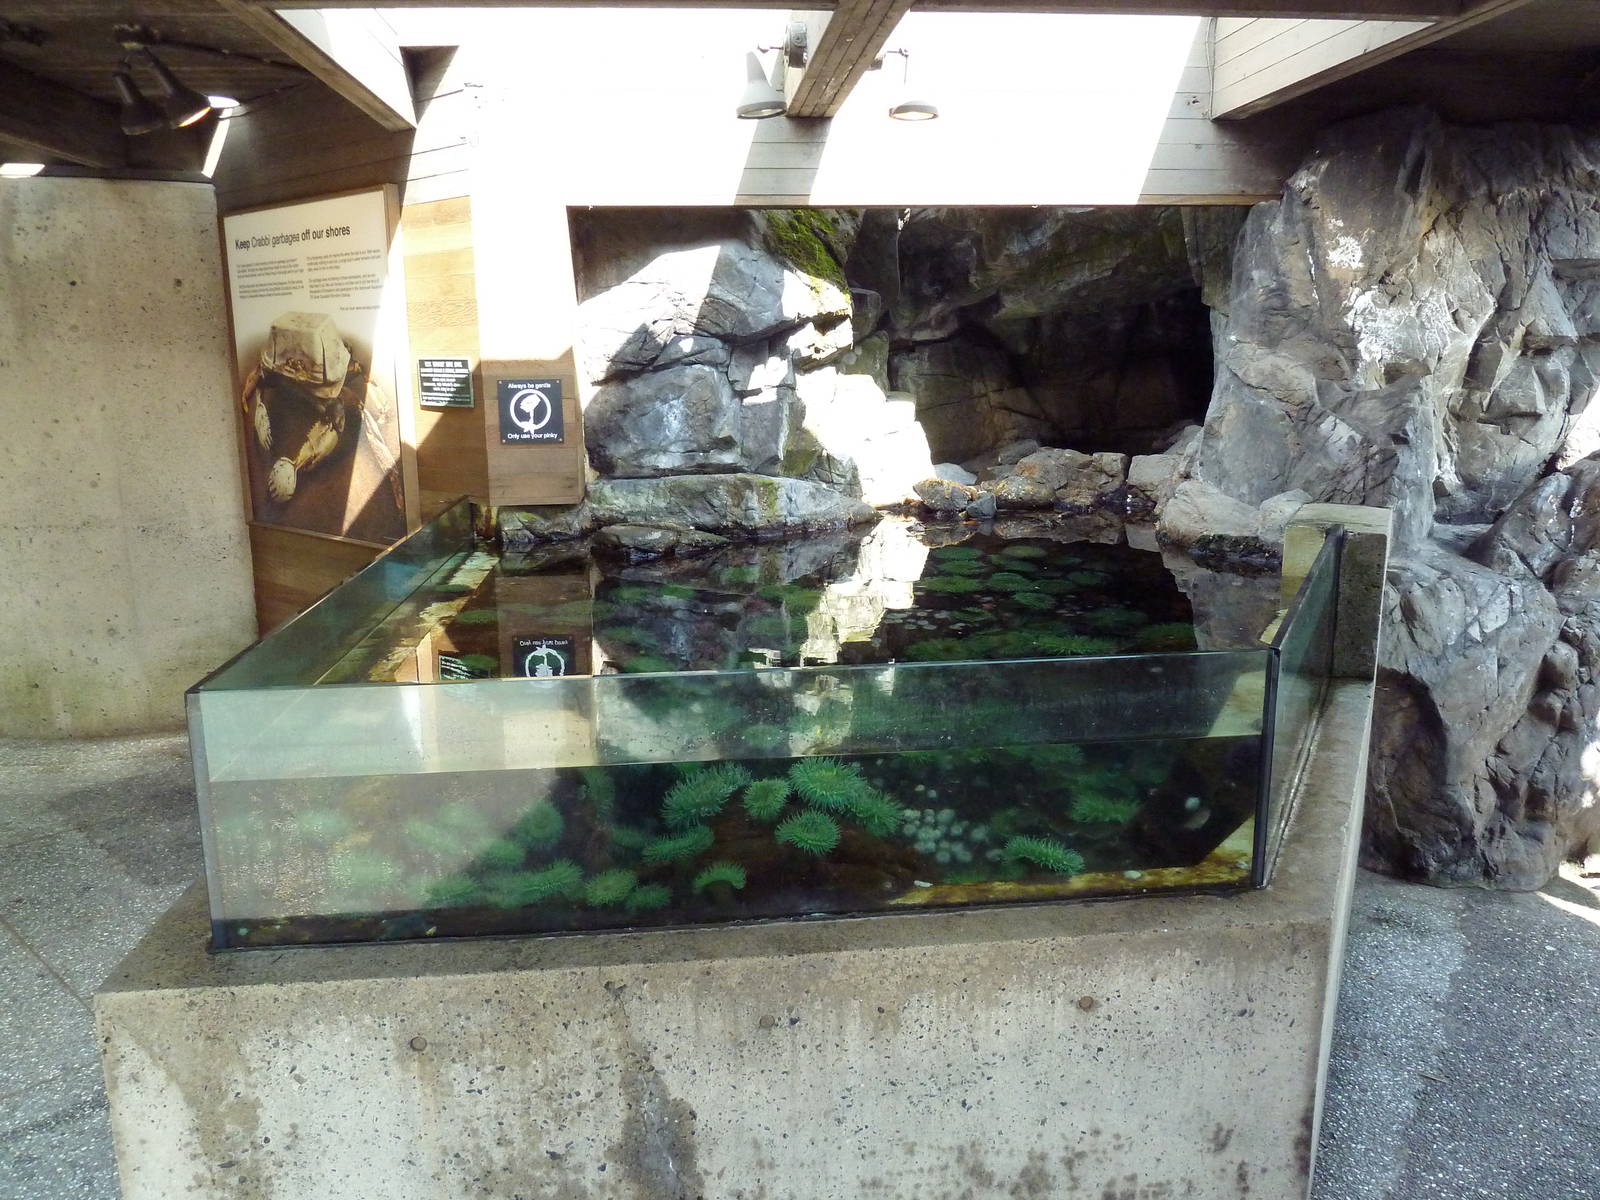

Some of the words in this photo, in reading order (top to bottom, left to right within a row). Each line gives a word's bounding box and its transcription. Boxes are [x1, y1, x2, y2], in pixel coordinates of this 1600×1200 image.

[235, 239, 250, 251] Keep
[301, 229, 311, 241] off
[312, 229, 324, 240] our
[325, 226, 351, 238] shores
